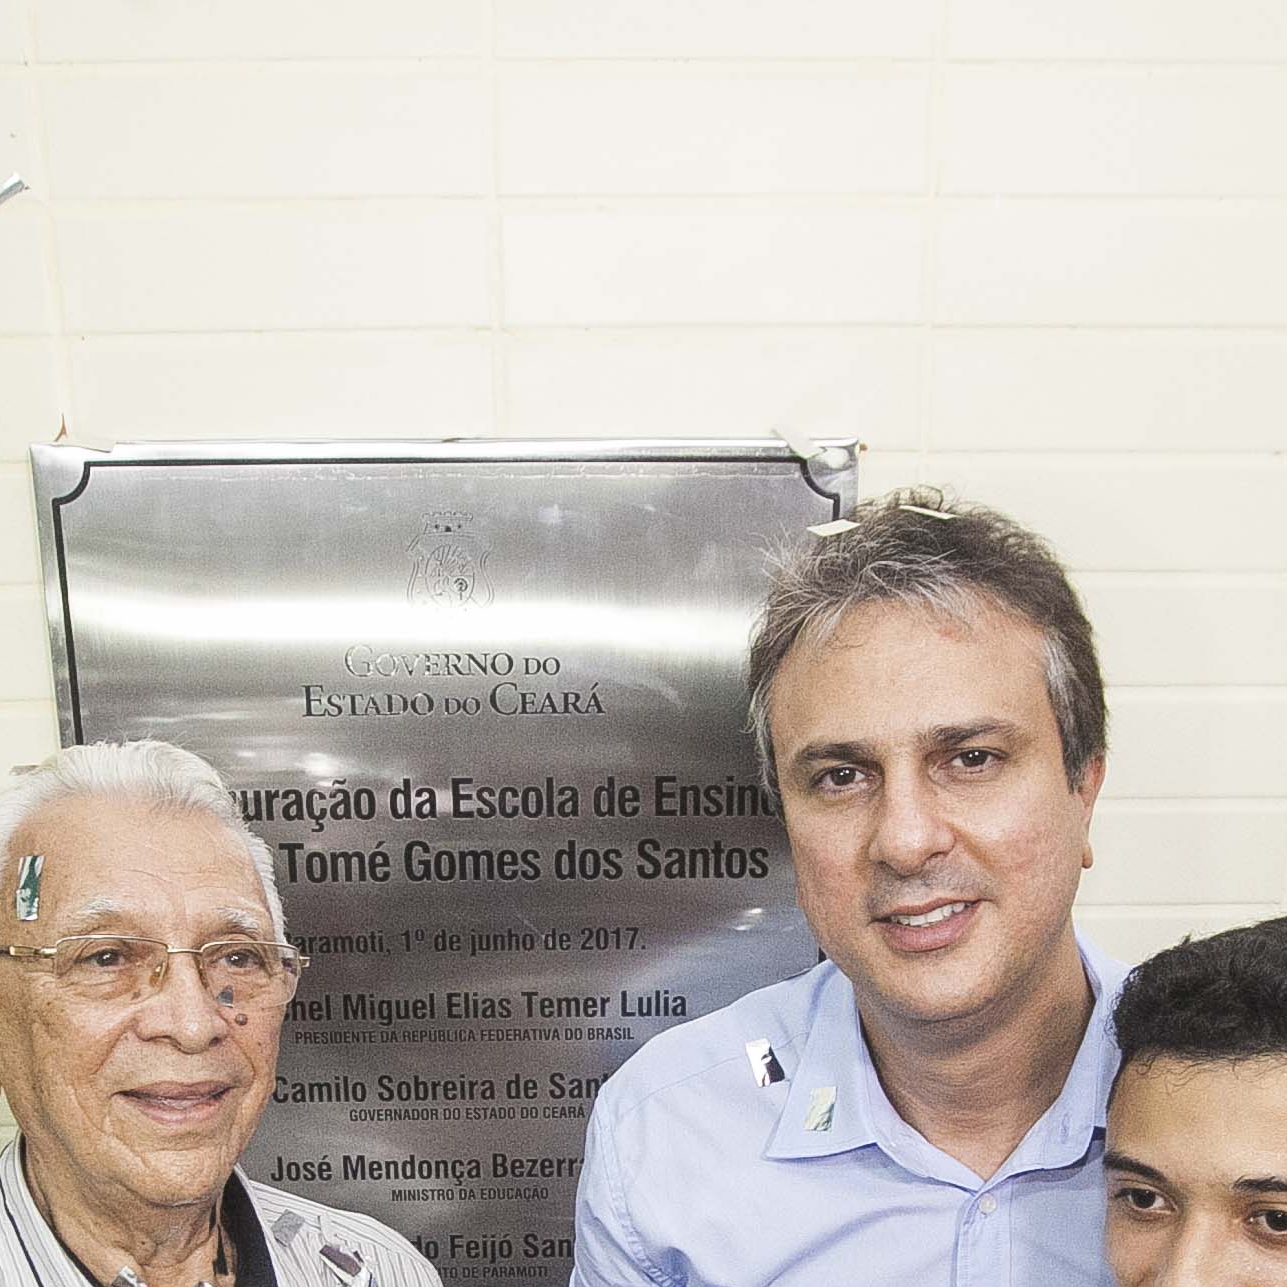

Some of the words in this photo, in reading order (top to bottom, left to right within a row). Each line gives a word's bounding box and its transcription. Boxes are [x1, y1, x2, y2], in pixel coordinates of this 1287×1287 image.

[345, 645, 513, 677] GOVERNO
[523, 657, 560, 676] DO
[302, 684, 434, 717] ESTADO
[444, 696, 481, 716] DO
[489, 682, 606, 717] CEARÁ
[228, 778, 376, 832] uração
[390, 778, 437, 820] da
[451, 777, 579, 820] Escola
[593, 776, 641, 818] de
[279, 841, 391, 883] Tomé
[404, 840, 541, 882] Gomes
[554, 840, 623, 880] dos
[637, 838, 769, 880] Santos
[434, 929, 461, 951] de
[469, 927, 535, 956] junho
[544, 928, 571, 950] de
[580, 927, 646, 950] 2017.
[343, 992, 435, 1026] Miguel
[447, 991, 512, 1020] Elias
[521, 991, 610, 1018] Temer
[620, 990, 687, 1017] Lulia
[295, 1031, 375, 1045] PRESIDENTE
[380, 1030, 399, 1044] DA
[480, 1028, 561, 1041] FEDERATIVA
[565, 1028, 583, 1041] DO
[588, 1027, 635, 1041] BRASIL
[273, 1075, 367, 1103] Camilo
[378, 1074, 496, 1102] Sobreira
[506, 1073, 538, 1100] de
[349, 1108, 439, 1121] GOVERNADOR
[444, 1108, 461, 1120] DO
[466, 1107, 516, 1120] ESTADO
[521, 1106, 539, 1119] DO
[543, 1104, 586, 1119] CEARÁ
[270, 1154, 333, 1181] José
[342, 1154, 481, 1186] Mendonça
[492, 1153, 585, 1178] Bezerr
[392, 1188, 454, 1201] MINISTRO
[458, 1188, 476, 1200] DA
[449, 1233, 513, 1264] Feijó
[462, 1267, 479, 1278] DE
[483, 1266, 548, 1278] PARAMOTI
